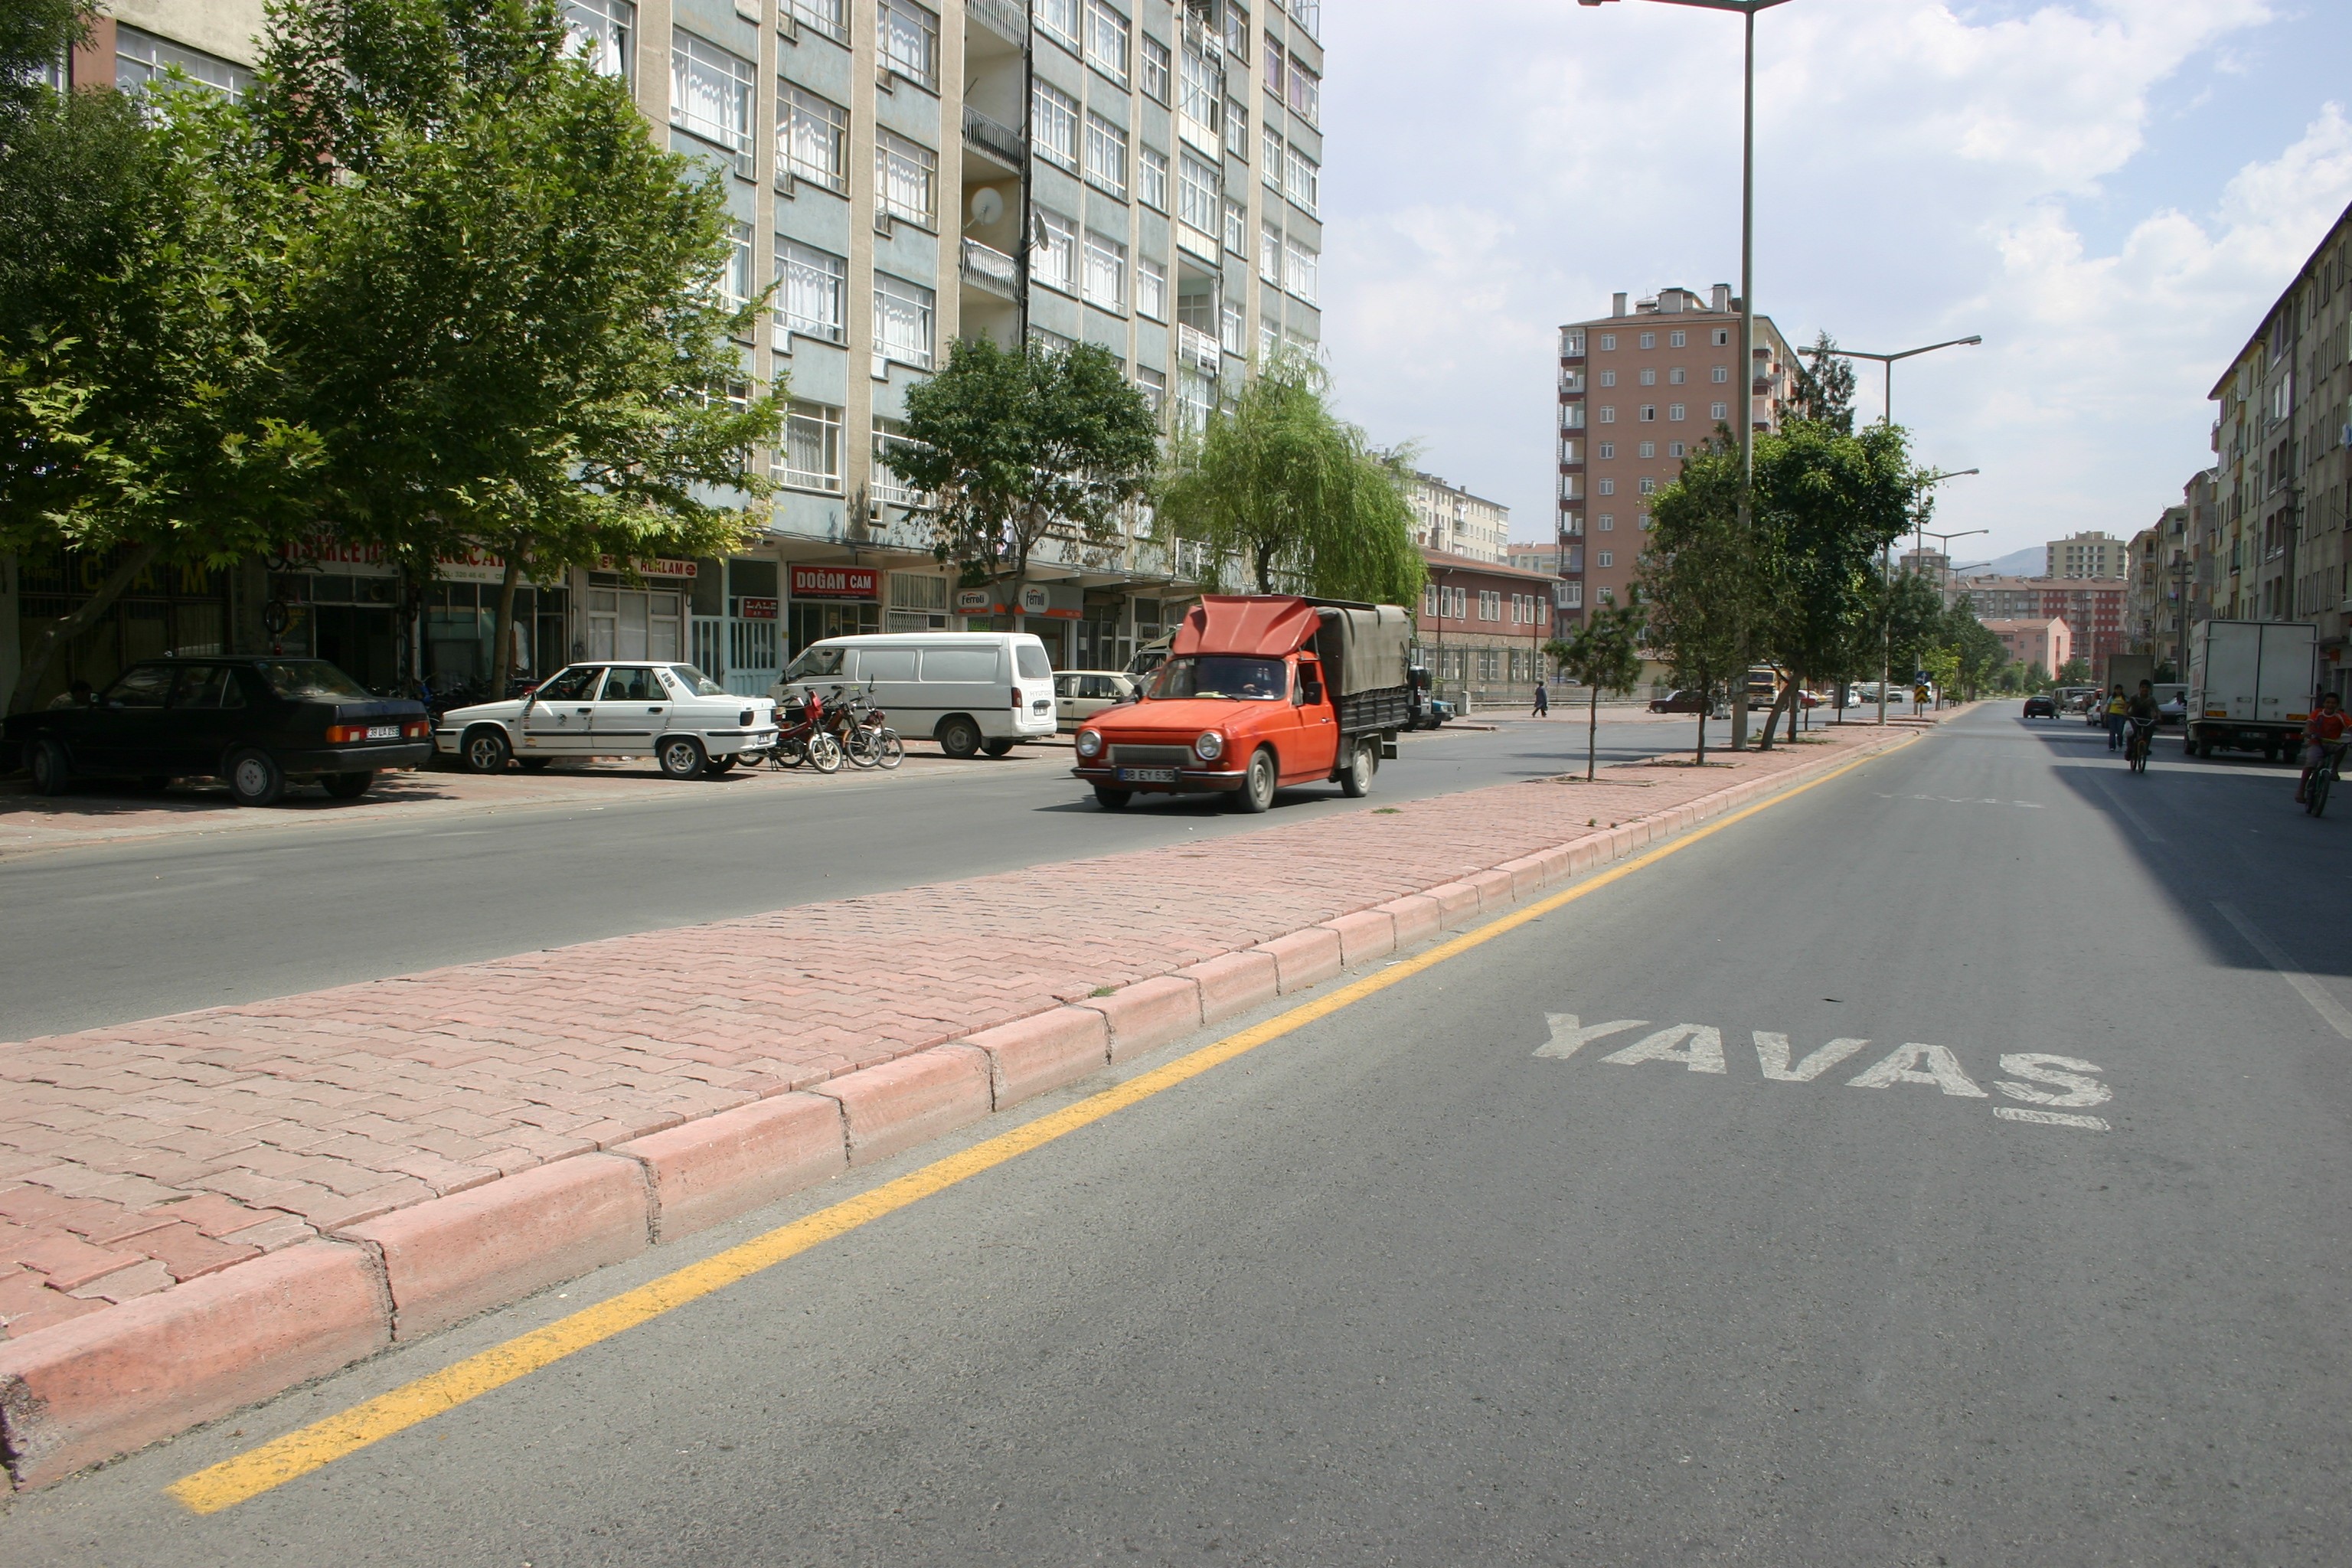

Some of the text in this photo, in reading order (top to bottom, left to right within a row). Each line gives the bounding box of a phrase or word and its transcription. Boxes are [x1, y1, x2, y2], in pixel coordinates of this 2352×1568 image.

[795, 569, 871, 590] DOĞAN CAM
[746, 600, 777, 610] LALE
[962, 594, 985, 605] Ferroli
[1026, 590, 1045, 607] Ferroli
